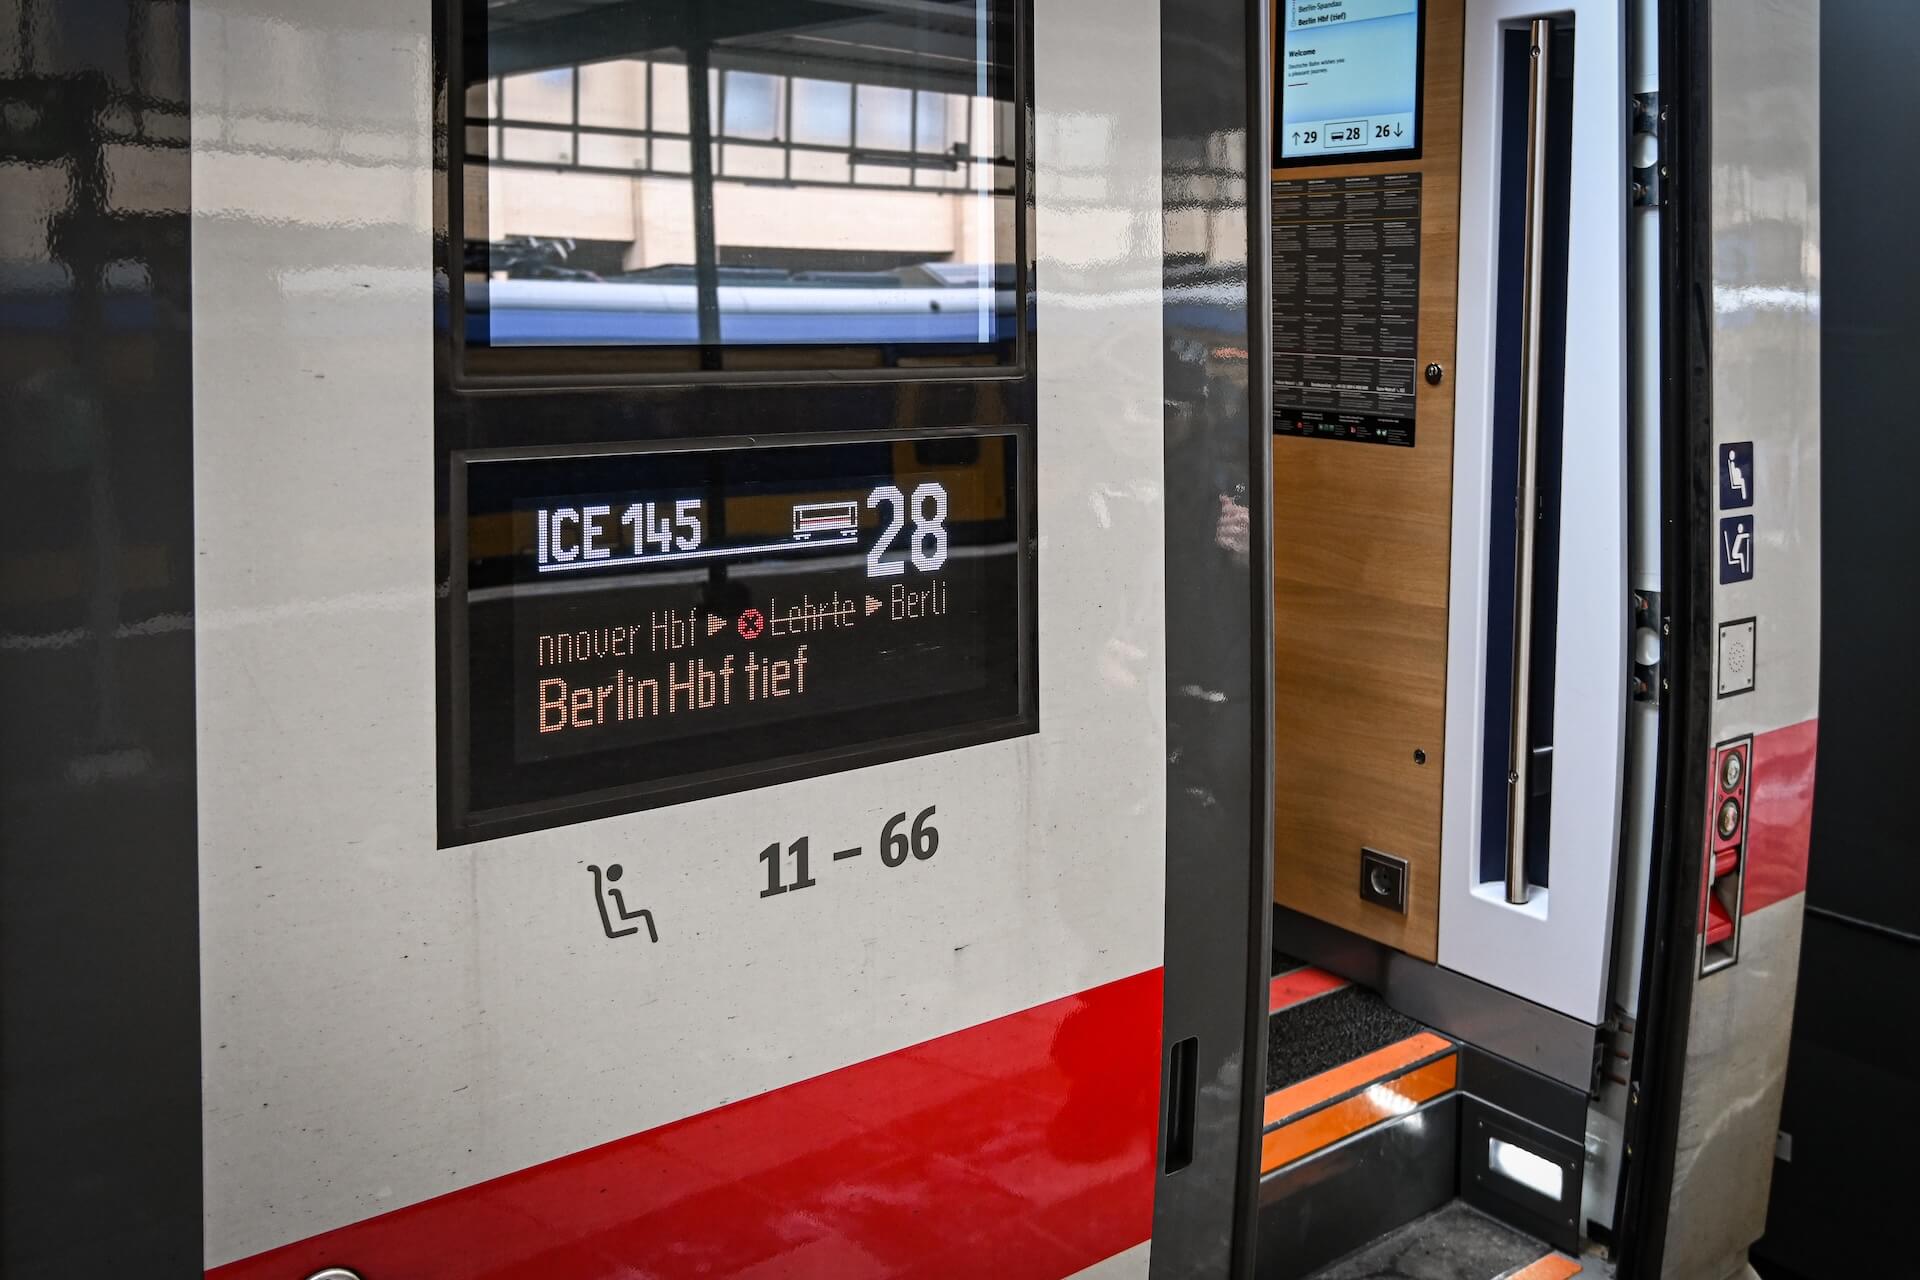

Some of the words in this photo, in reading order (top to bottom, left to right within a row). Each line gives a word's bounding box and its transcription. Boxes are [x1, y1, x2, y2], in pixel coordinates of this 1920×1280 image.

[1298, 17, 1316, 26] Berlin
[1317, 14, 1328, 23] Hbf
[1330, 11, 1346, 22] (tief)
[1289, 49, 1316, 57] Welcome
[1303, 131, 1318, 144] 29
[1346, 127, 1360, 141] 28
[1375, 124, 1390, 138] 26
[538, 506, 610, 564] ICE
[622, 499, 702, 556] 145
[867, 482, 949, 578] 28
[538, 623, 642, 666] nnover
[652, 607, 698, 652] Hbf
[770, 591, 857, 637] Lehrte
[891, 579, 947, 621] Berli
[538, 669, 659, 734] Berlin
[669, 654, 735, 713] Hbf
[744, 644, 808, 702] tief
[759, 836, 816, 899] 11
[879, 805, 940, 868] 66
